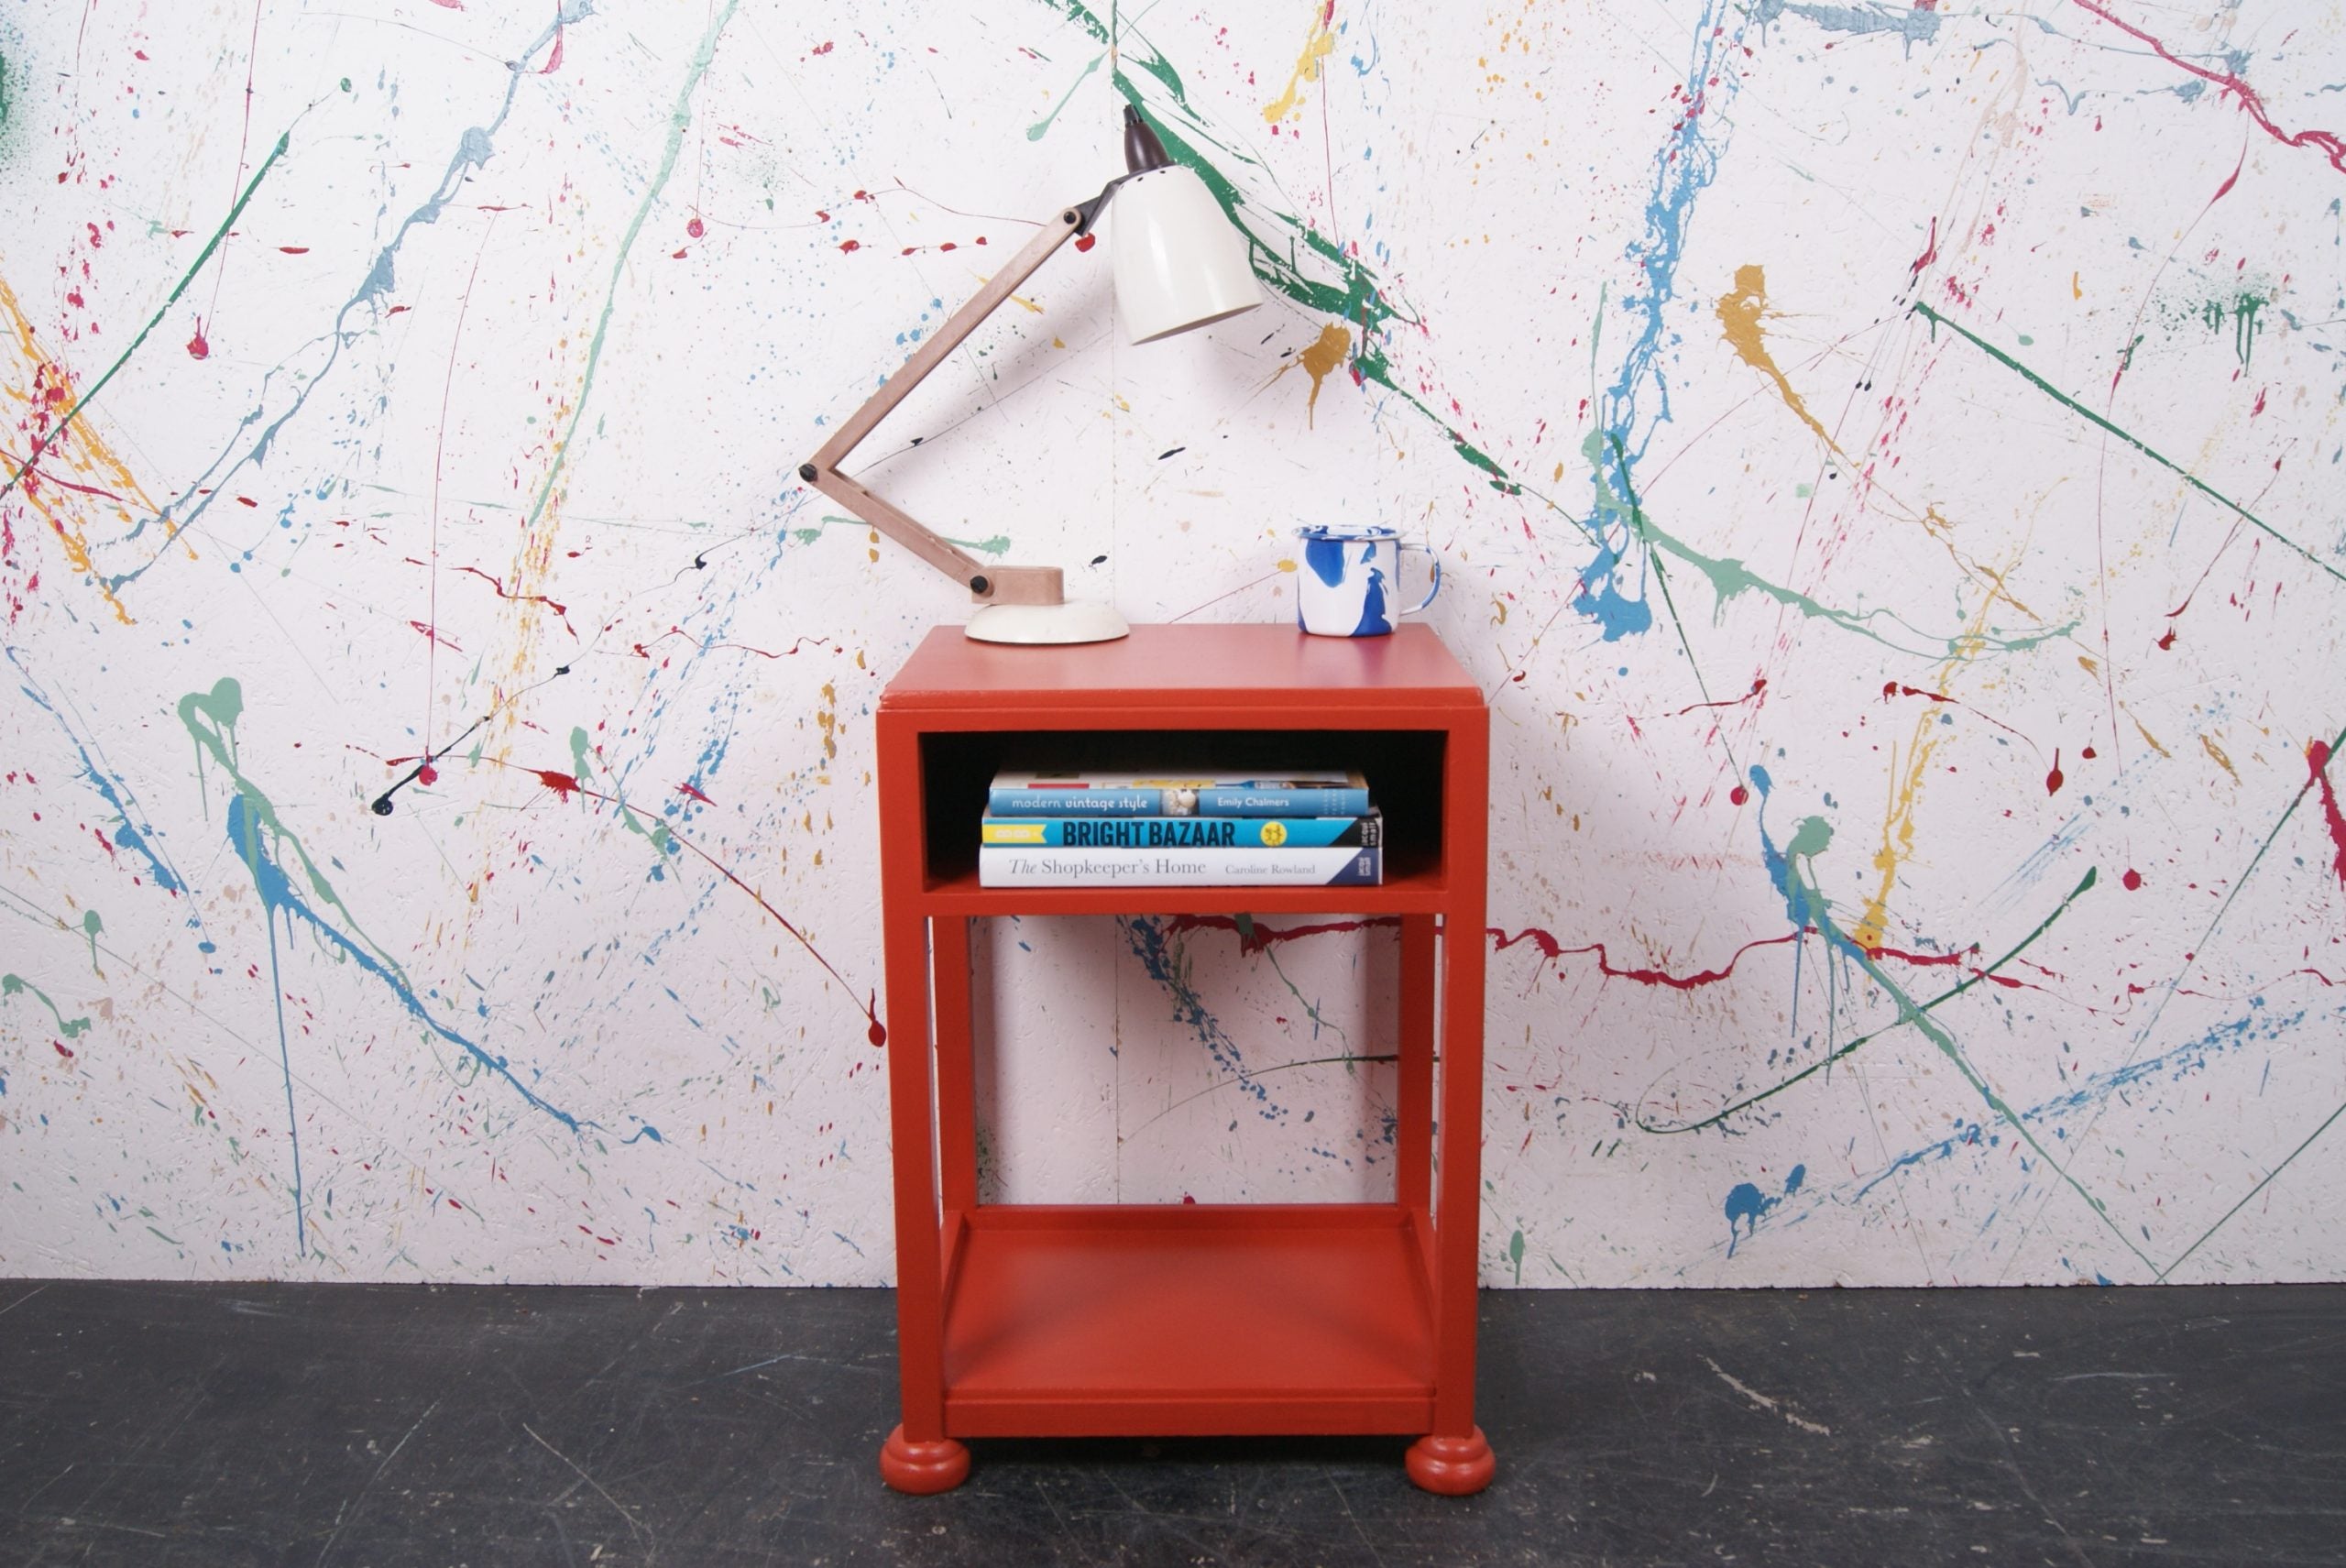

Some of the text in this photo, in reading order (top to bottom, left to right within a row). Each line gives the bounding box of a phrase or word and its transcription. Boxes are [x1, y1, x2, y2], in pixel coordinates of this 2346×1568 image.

[1012, 795, 1148, 811] modern vintage style
[1217, 796, 1289, 808] Emily Chalmers
[1063, 821, 1235, 847] BRIGHT BAZAAR
[1010, 859, 1037, 874] The
[1156, 859, 1207, 874] Home
[1225, 863, 1316, 874] Caroline Rowland
